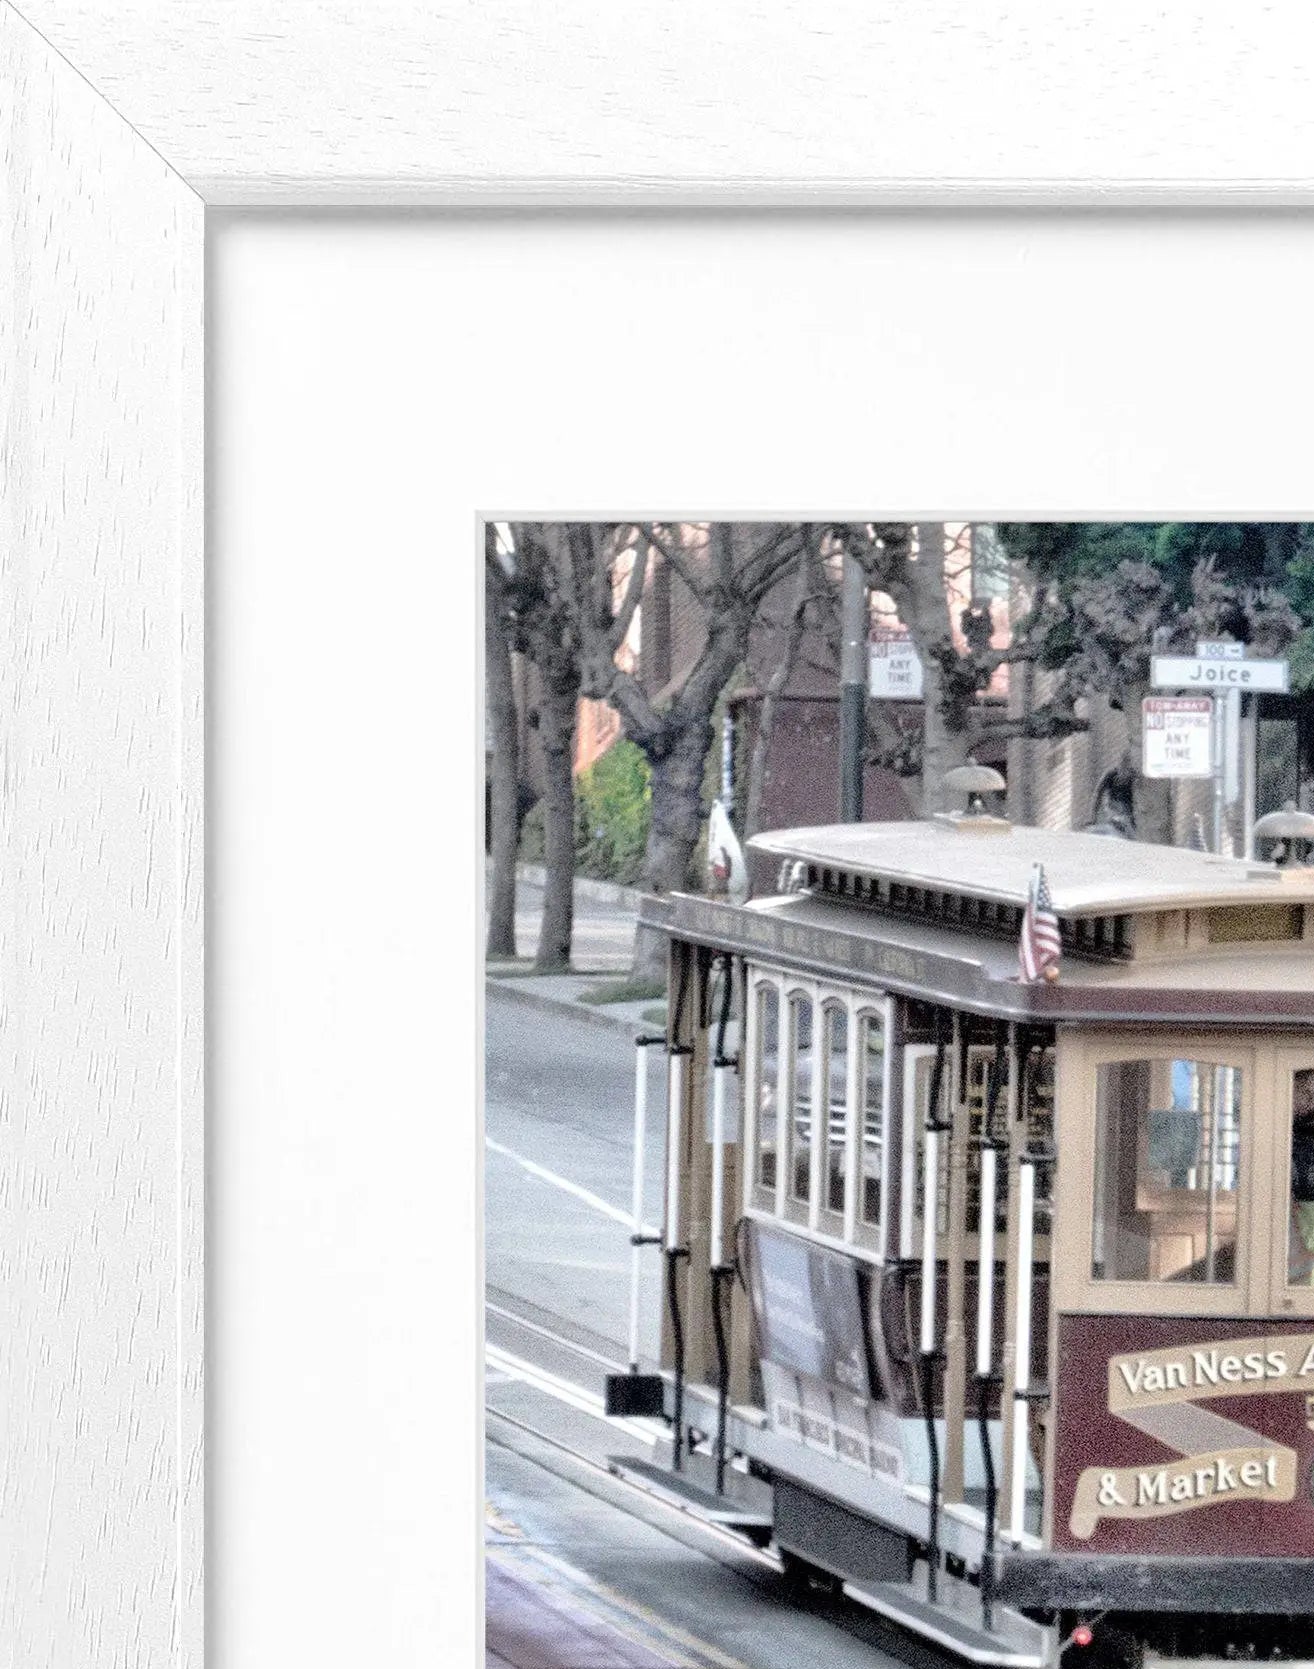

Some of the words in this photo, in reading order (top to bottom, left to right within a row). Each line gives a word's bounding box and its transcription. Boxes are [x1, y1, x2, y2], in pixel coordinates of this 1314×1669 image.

[1190, 665, 1252, 682] Joice
[1165, 732, 1190, 744] ANY
[1165, 747, 1191, 760] TIME
[1118, 1360, 1187, 1396] Van
[1193, 1346, 1288, 1386] Ness
[1097, 1474, 1123, 1506] &
[1136, 1458, 1279, 1505] Market
